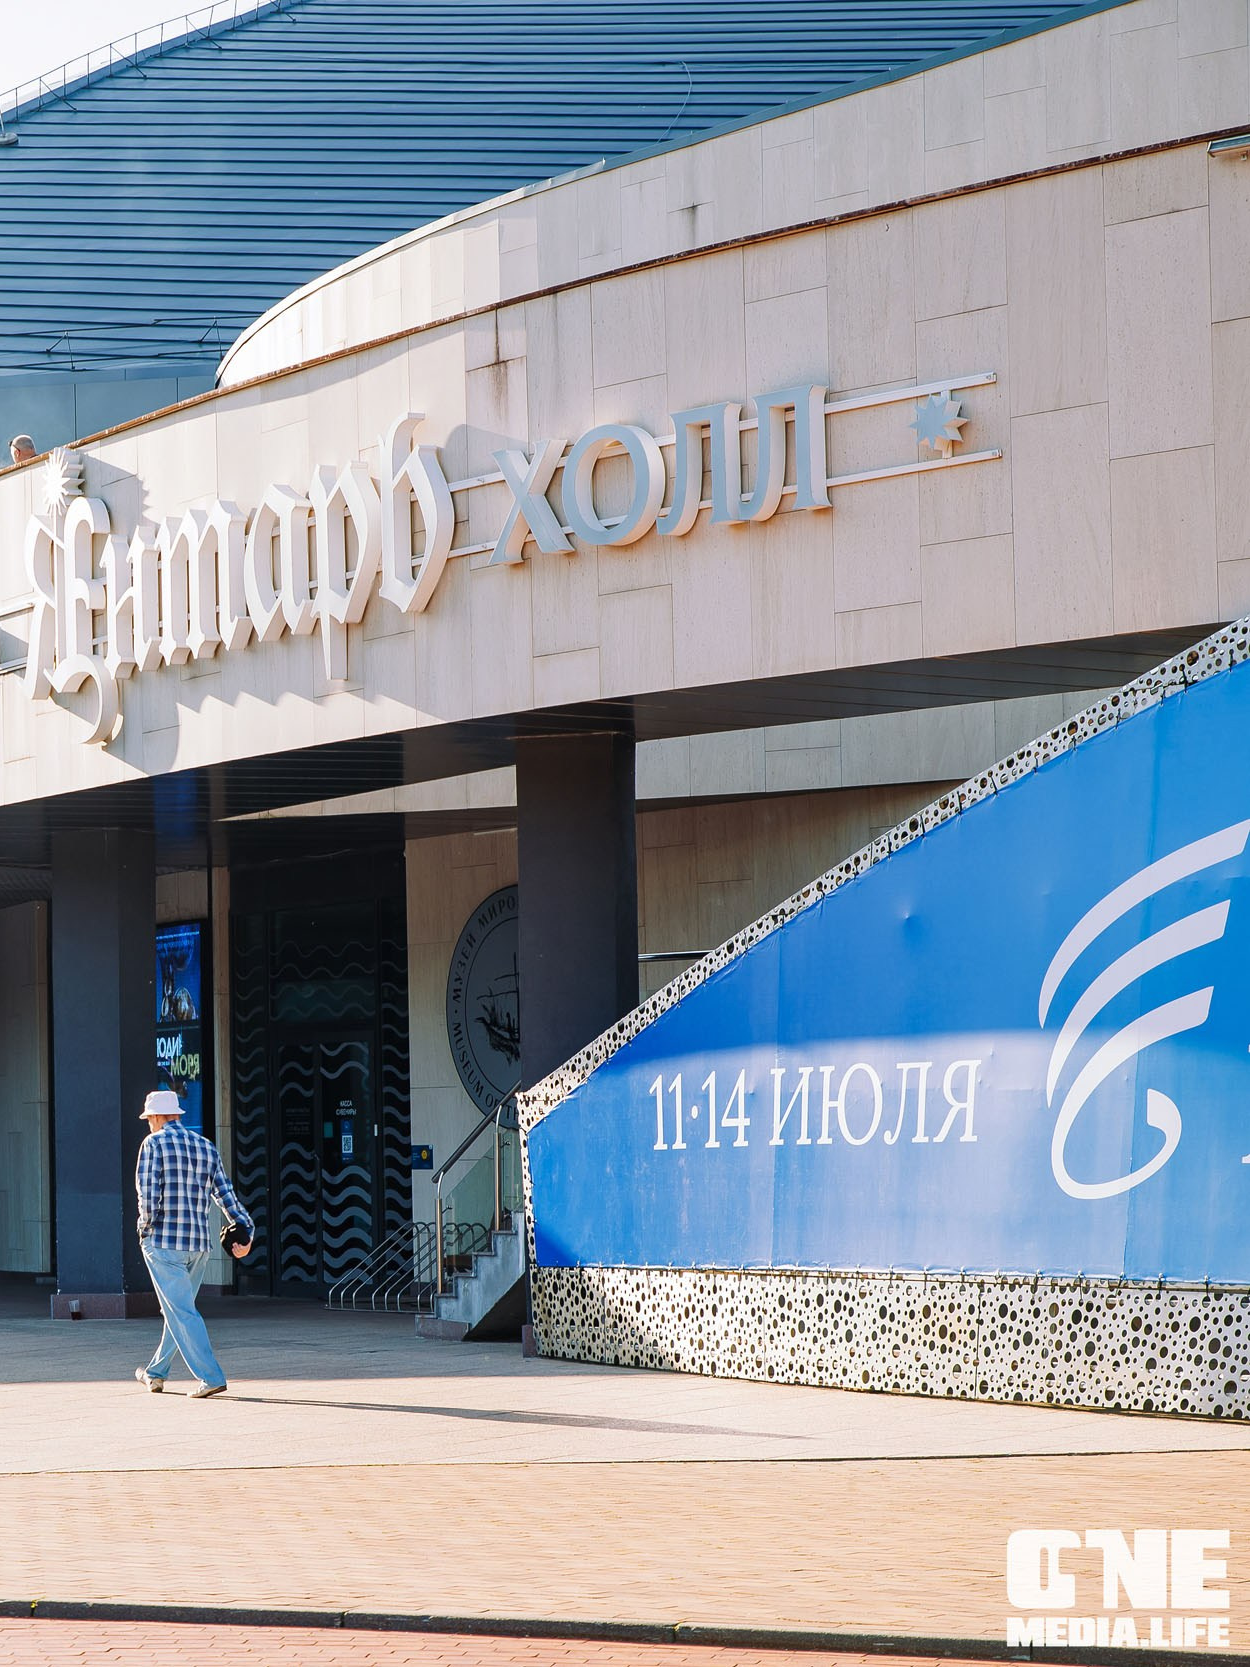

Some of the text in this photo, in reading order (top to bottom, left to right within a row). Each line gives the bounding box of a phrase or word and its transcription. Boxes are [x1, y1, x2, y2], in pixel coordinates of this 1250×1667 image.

[488, 383, 833, 566] ХОЛЛ
[171, 1054, 200, 1076] МОРЯ
[453, 1022, 484, 1098] MUSEUM
[769, 1059, 981, 1146] ИЮЛЯ
